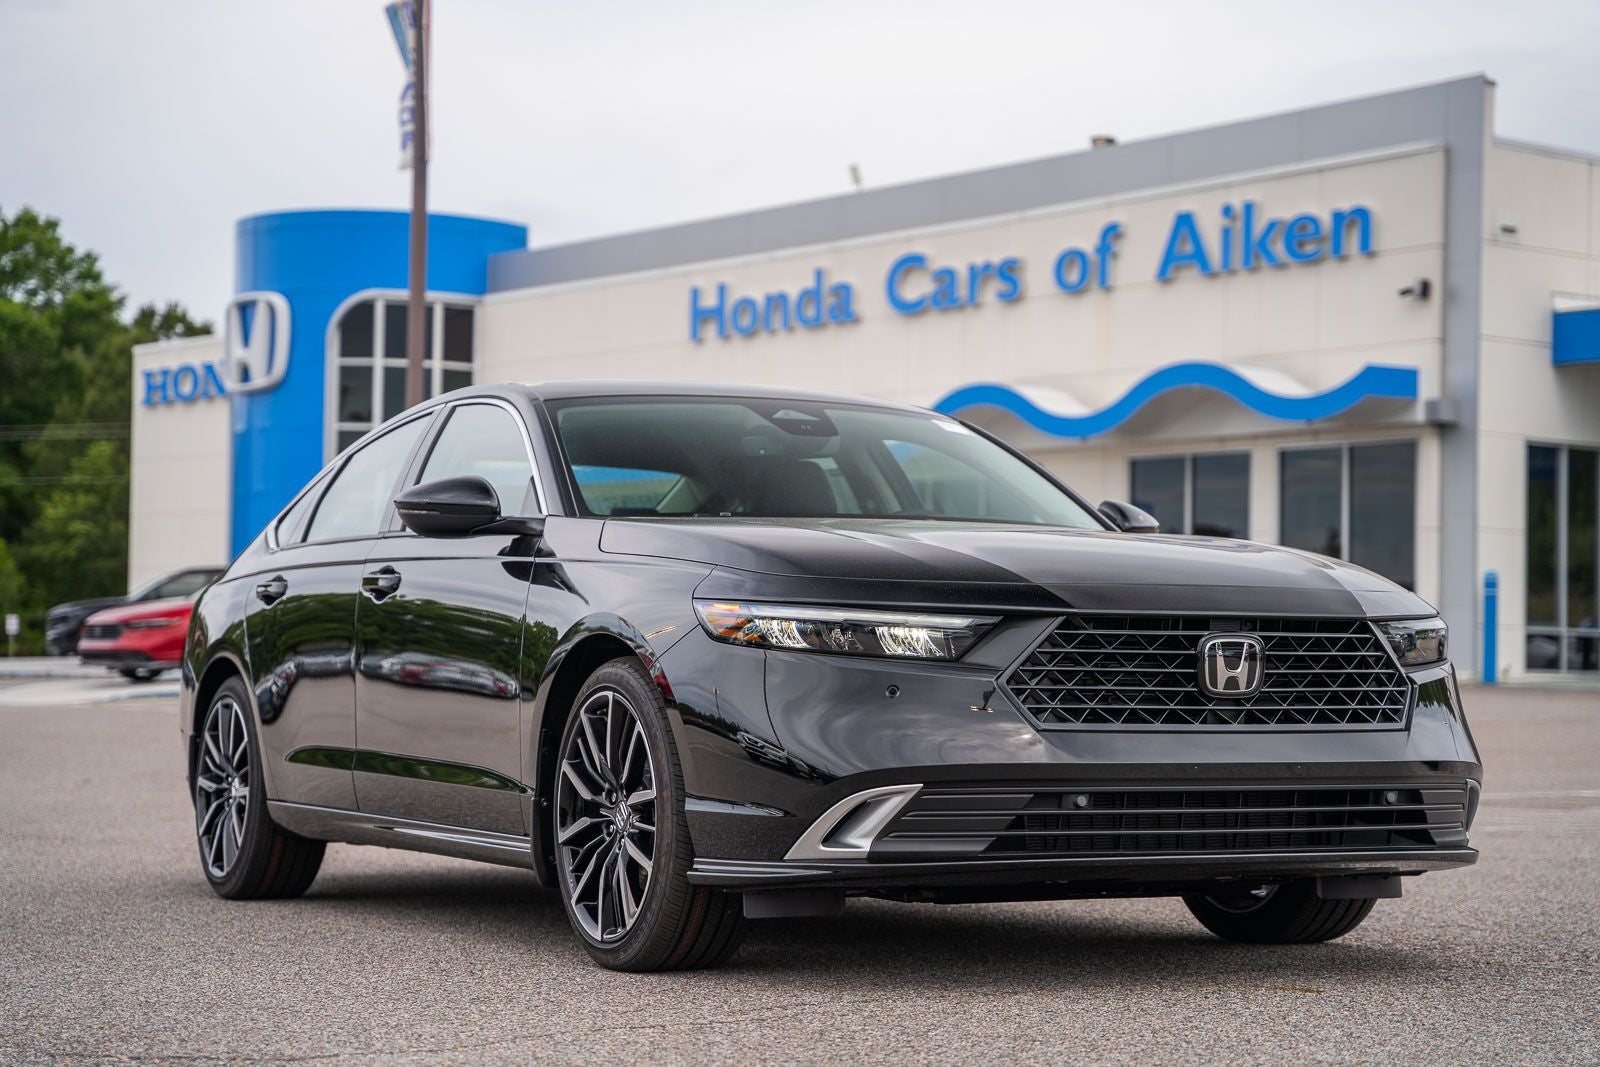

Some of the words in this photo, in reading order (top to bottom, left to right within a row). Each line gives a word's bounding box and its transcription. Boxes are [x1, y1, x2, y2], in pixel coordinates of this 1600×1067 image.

[690, 268, 857, 342] Honda
[886, 252, 1021, 315] Cars
[1053, 222, 1122, 293] of
[1156, 201, 1375, 281] Aiken
